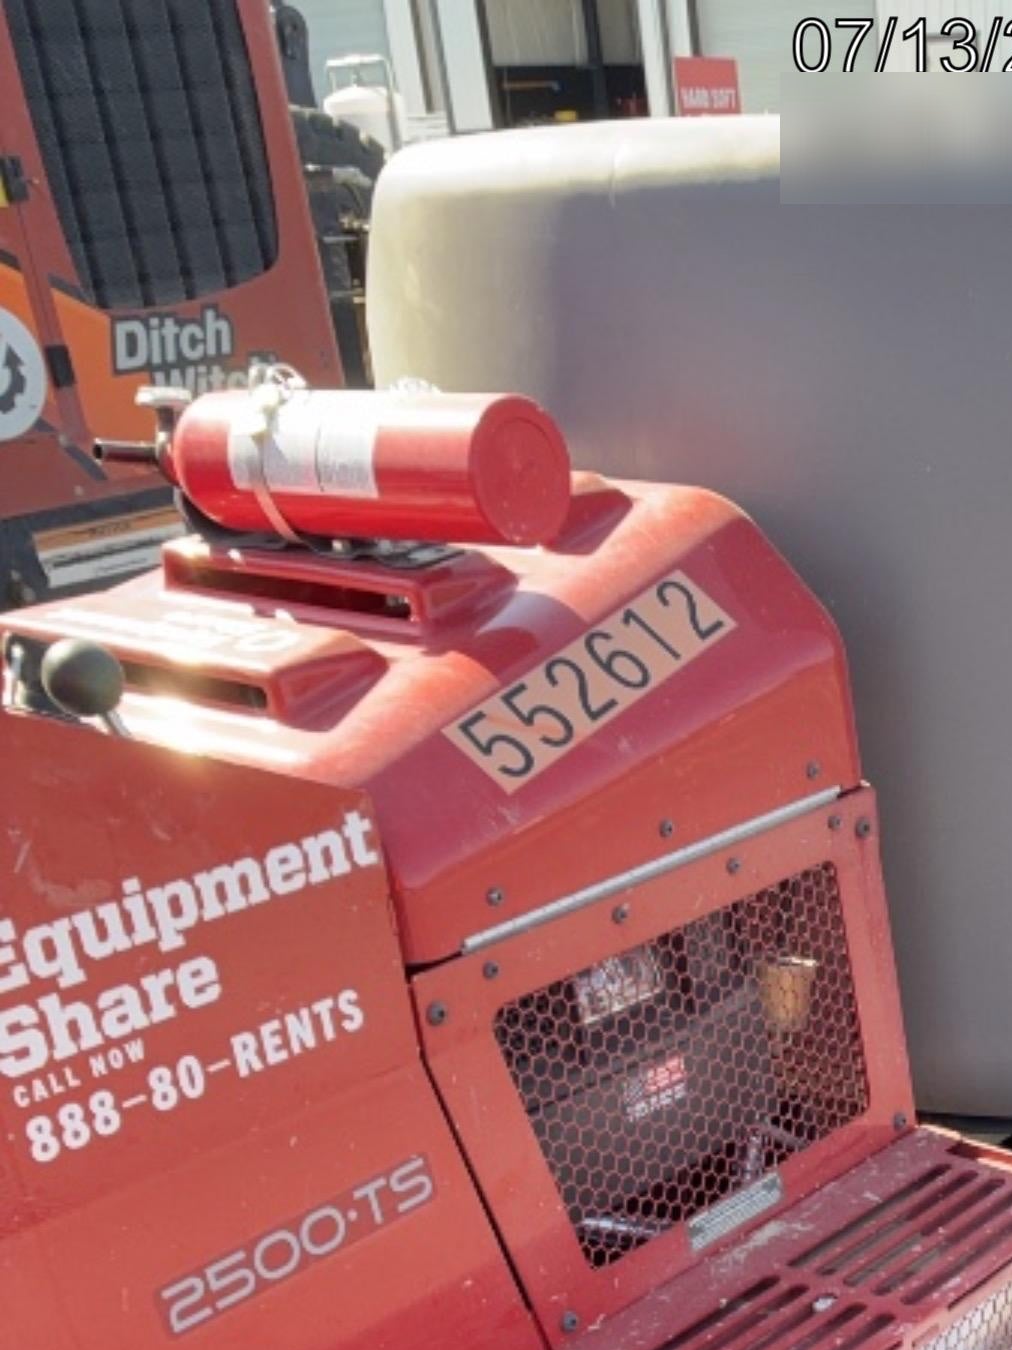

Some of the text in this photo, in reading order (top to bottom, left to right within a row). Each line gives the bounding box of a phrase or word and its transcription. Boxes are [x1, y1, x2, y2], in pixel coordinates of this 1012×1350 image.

[114, 307, 232, 371] Ditch
[458, 577, 726, 779] 552612
[0, 810, 380, 993] Equipment
[0, 955, 223, 1077] Share
[13, 1037, 146, 1108] CALL NOW
[25, 989, 365, 1163] 888-80-RENTS
